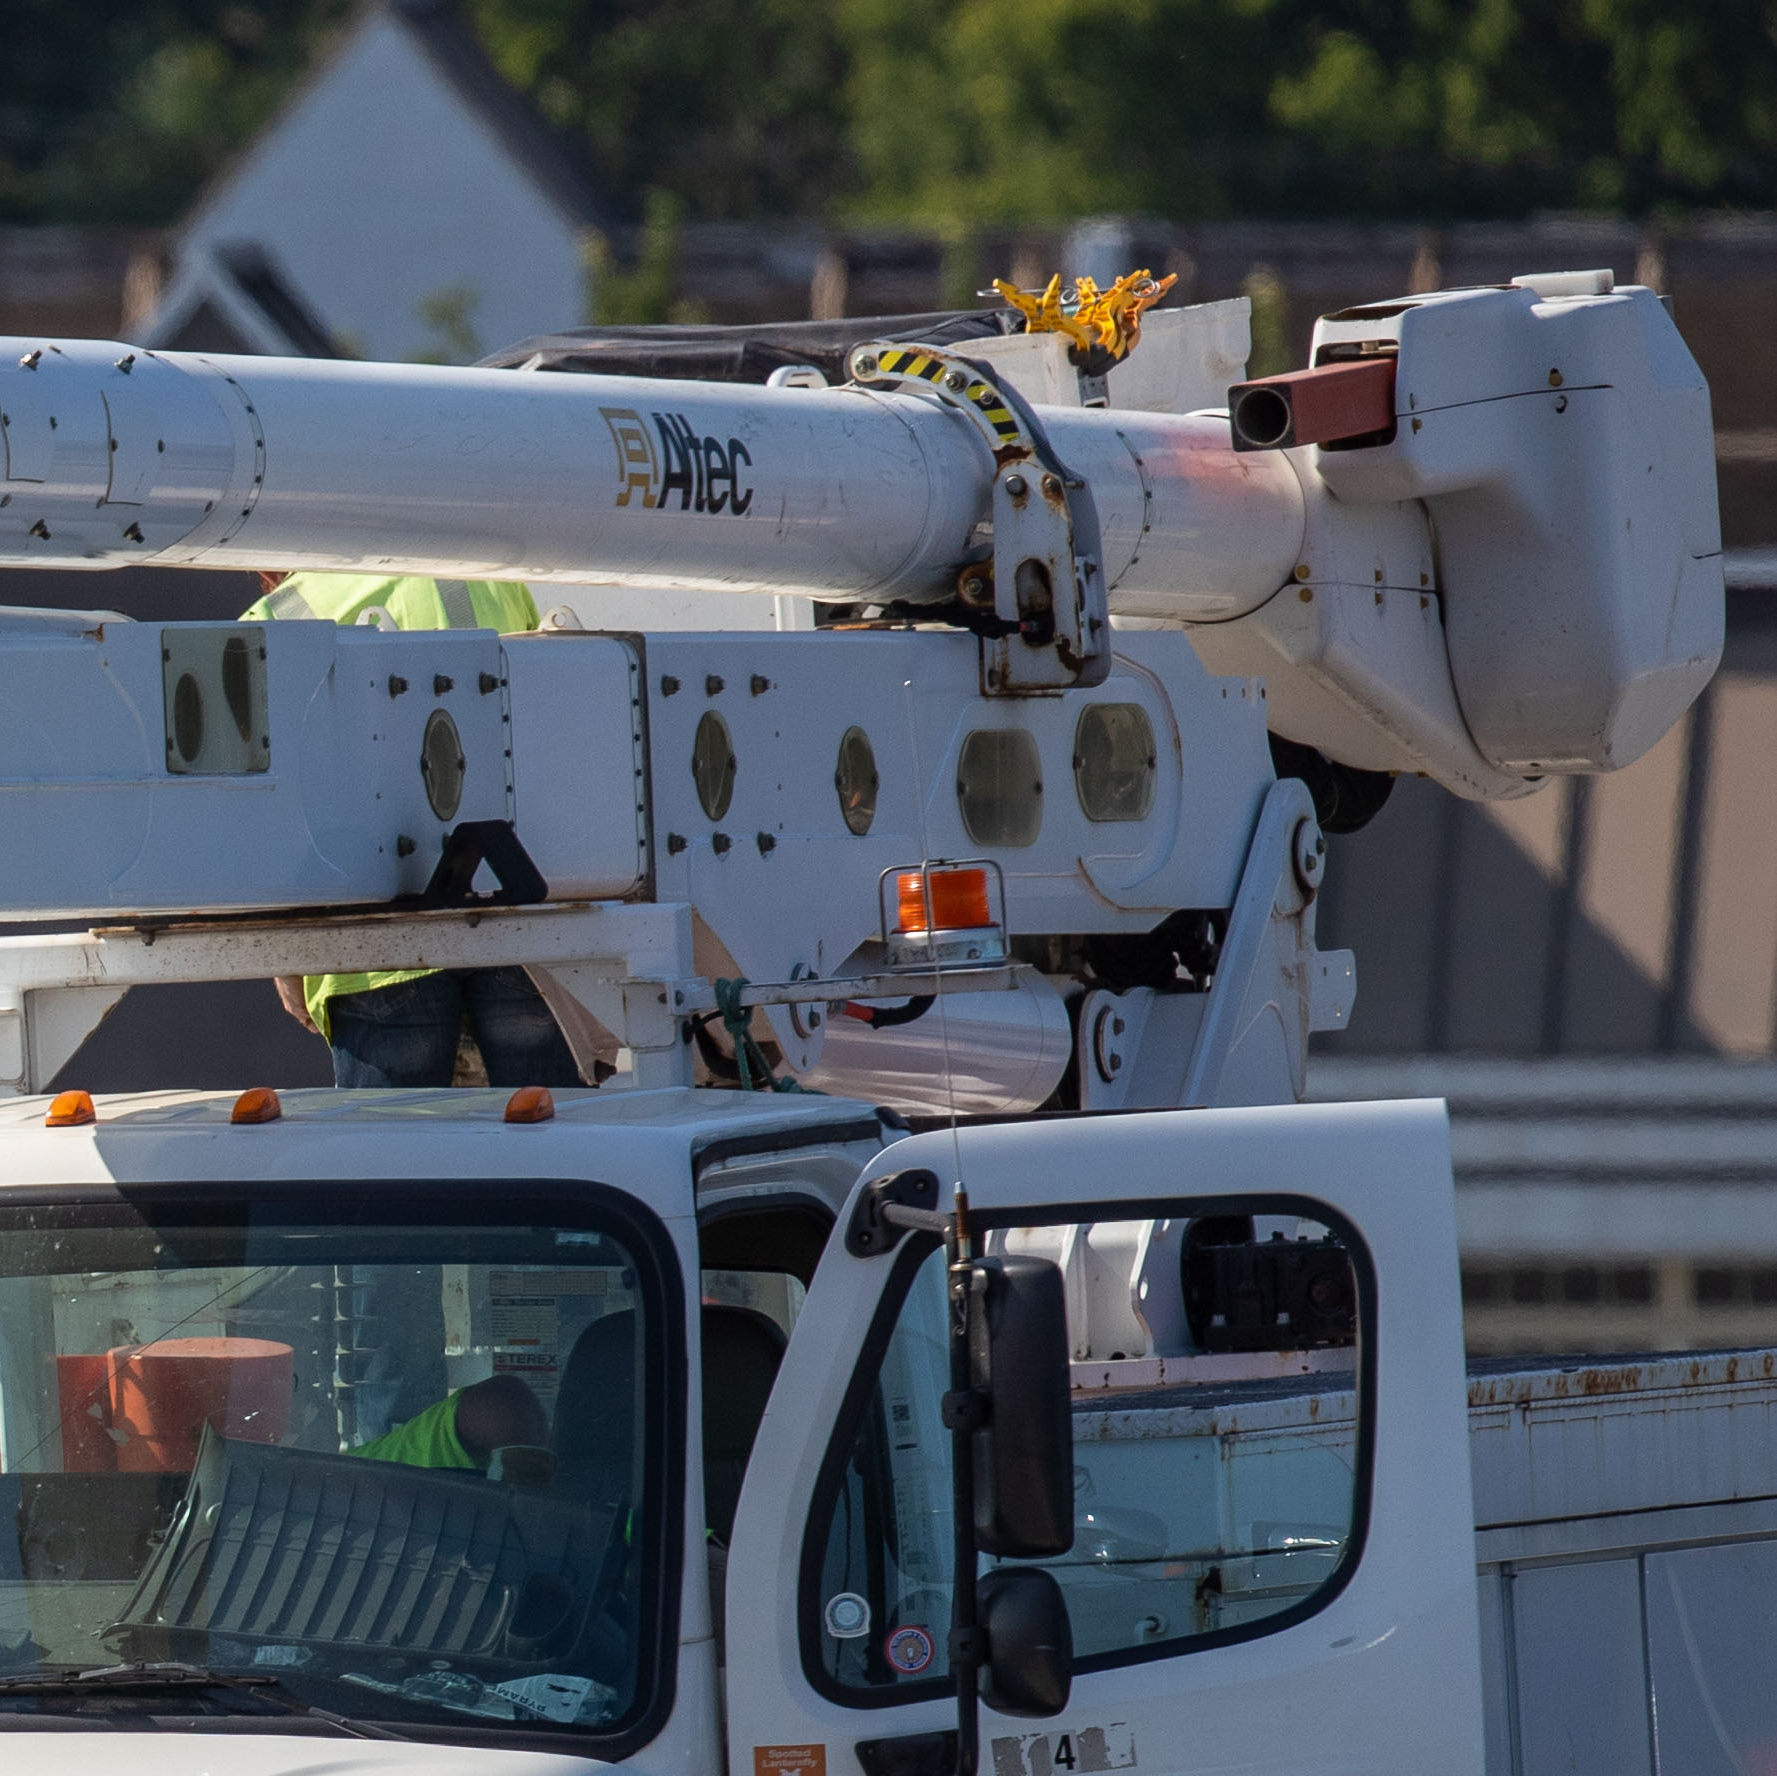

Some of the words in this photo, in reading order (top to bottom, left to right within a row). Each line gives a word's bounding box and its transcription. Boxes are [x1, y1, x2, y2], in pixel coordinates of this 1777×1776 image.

[651, 412, 754, 516] Altec
[768, 1749, 811, 1760] Spotted
[1054, 1734, 1076, 1770] 4
